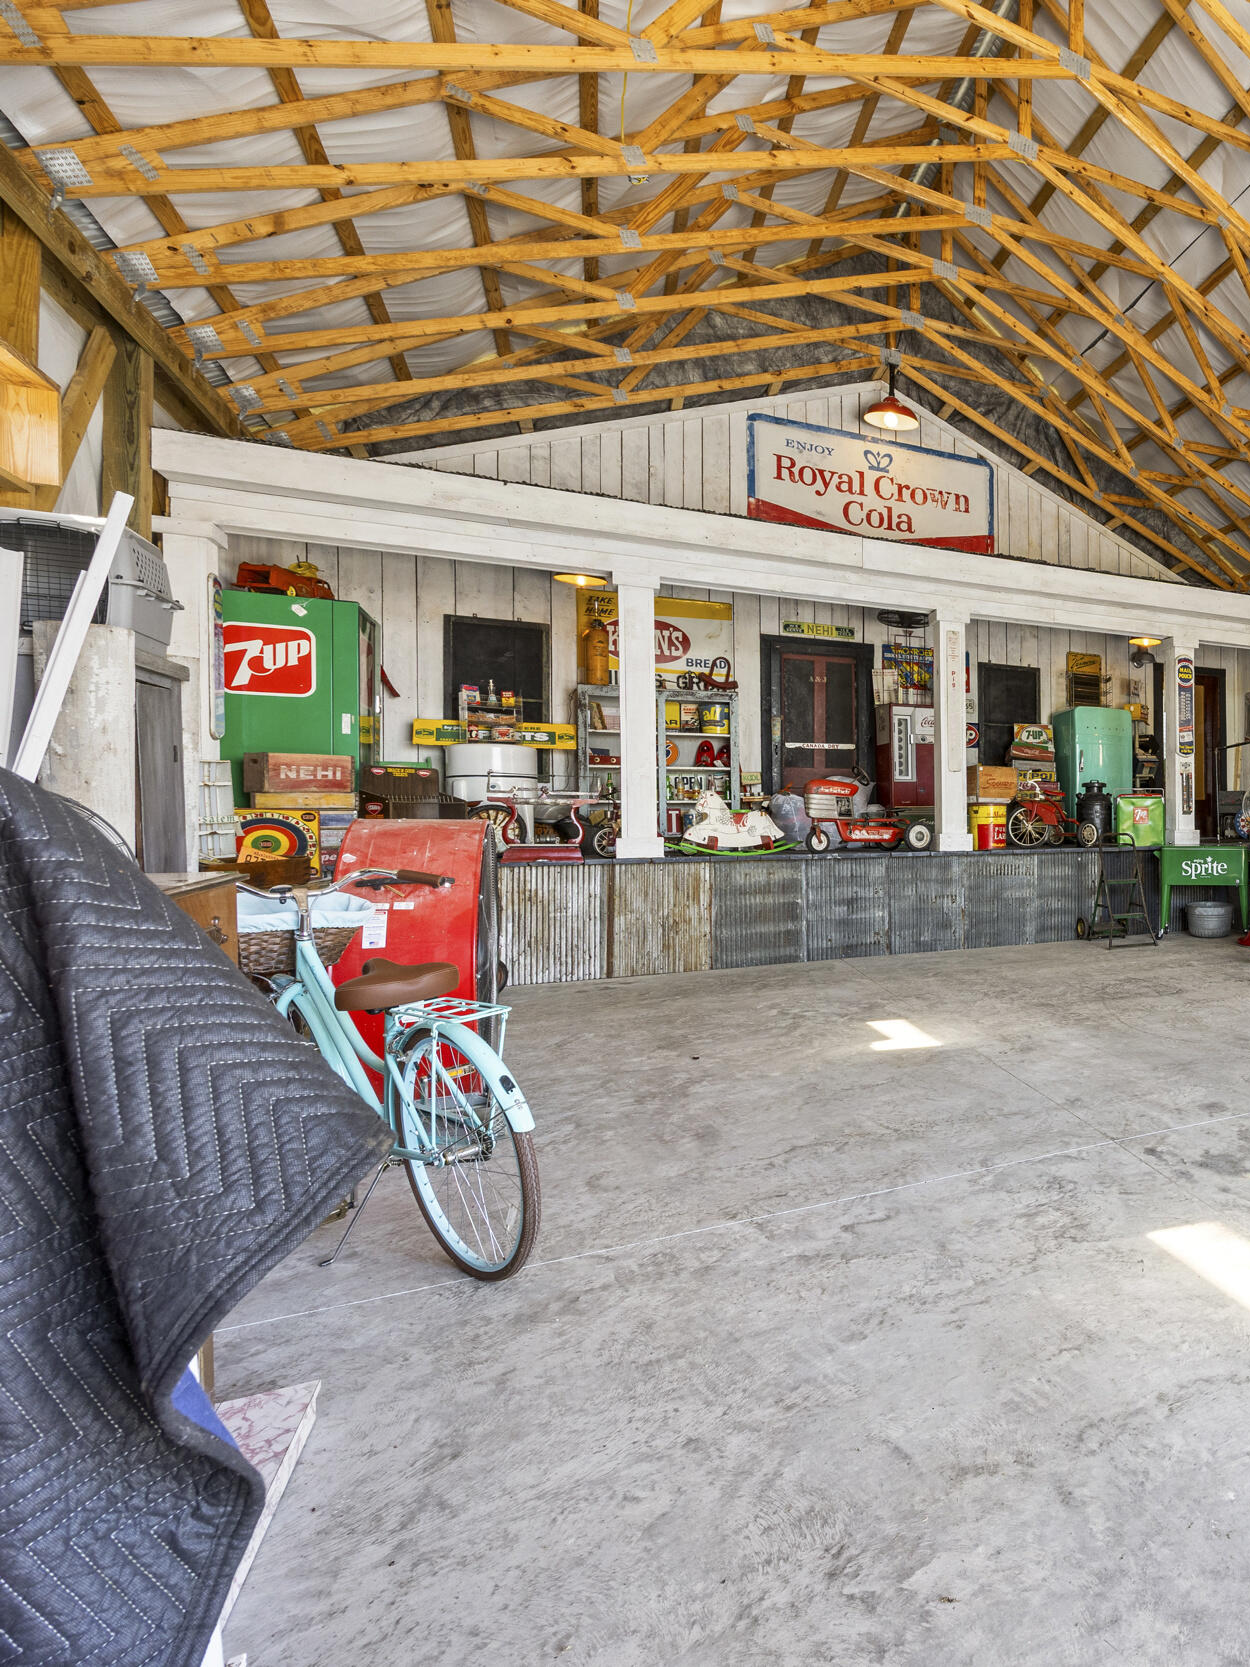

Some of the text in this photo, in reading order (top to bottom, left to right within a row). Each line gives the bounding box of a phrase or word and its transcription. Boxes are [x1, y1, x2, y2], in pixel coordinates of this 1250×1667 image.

[785, 438, 834, 456] ENJOY
[772, 453, 970, 514] Royal Crown
[842, 500, 915, 534] Cola
[586, 596, 614, 605] TAKE
[584, 607, 615, 616] HOME
[807, 624, 834, 636] NEHI
[224, 639, 310, 686] 7UP
[686, 658, 727, 670] BREAD
[478, 730, 550, 741] PRTS
[280, 765, 342, 780] NEHI
[674, 776, 702, 790] OPEN
[202, 814, 236, 823] salem
[1182, 857, 1228, 880] Sprite
